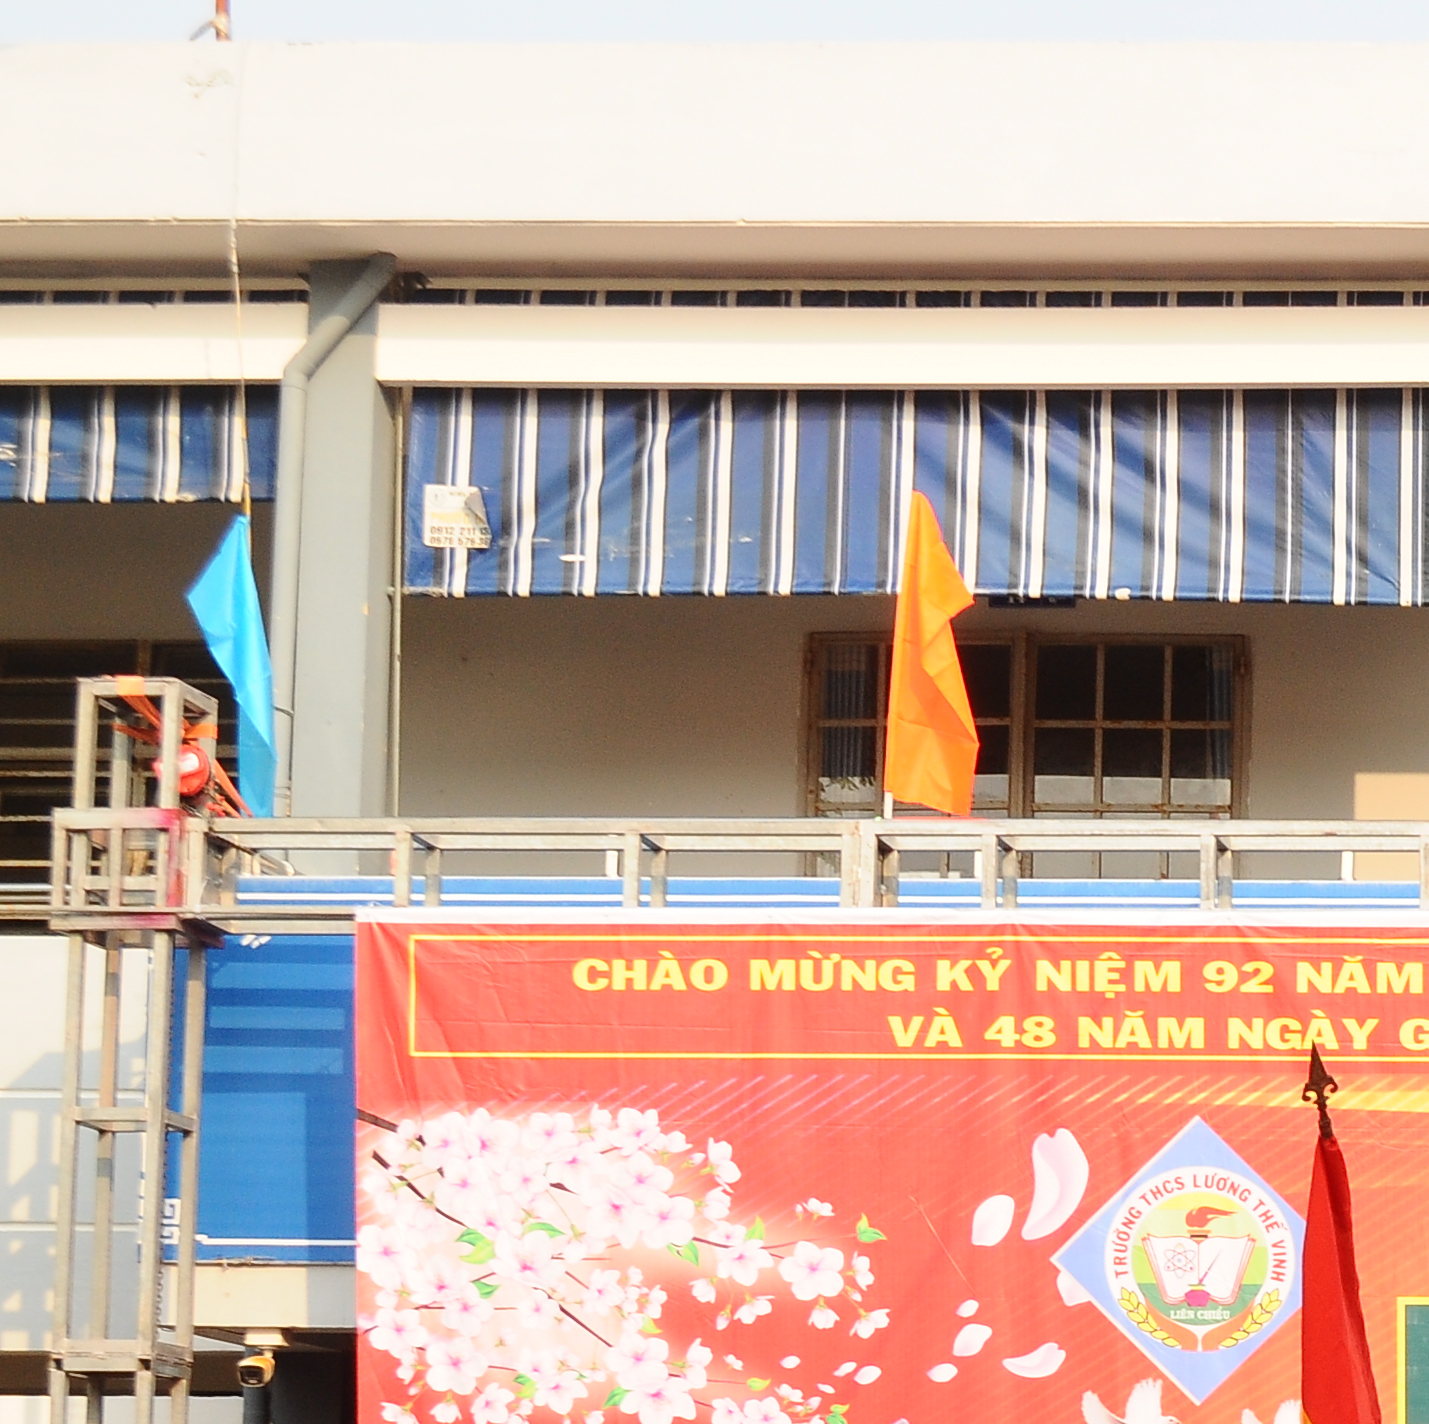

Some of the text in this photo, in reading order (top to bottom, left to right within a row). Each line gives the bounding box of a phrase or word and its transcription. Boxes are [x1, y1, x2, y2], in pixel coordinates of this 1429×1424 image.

[571, 949, 730, 993] CHÀO
[748, 949, 917, 993] MỪNG
[934, 945, 1013, 993] KỶ
[1034, 950, 1183, 1000] NIỆM
[1201, 959, 1276, 994] 92
[1295, 954, 1425, 995] NĂM
[886, 1005, 965, 1049] VÀ
[982, 1014, 1058, 1049] 48
[1076, 1009, 1206, 1050] NĂM
[1226, 1008, 1381, 1052] NGÀY
[1113, 1173, 1288, 1282] TRƯỜNG THCS LƯƠNG THẾ VINH
